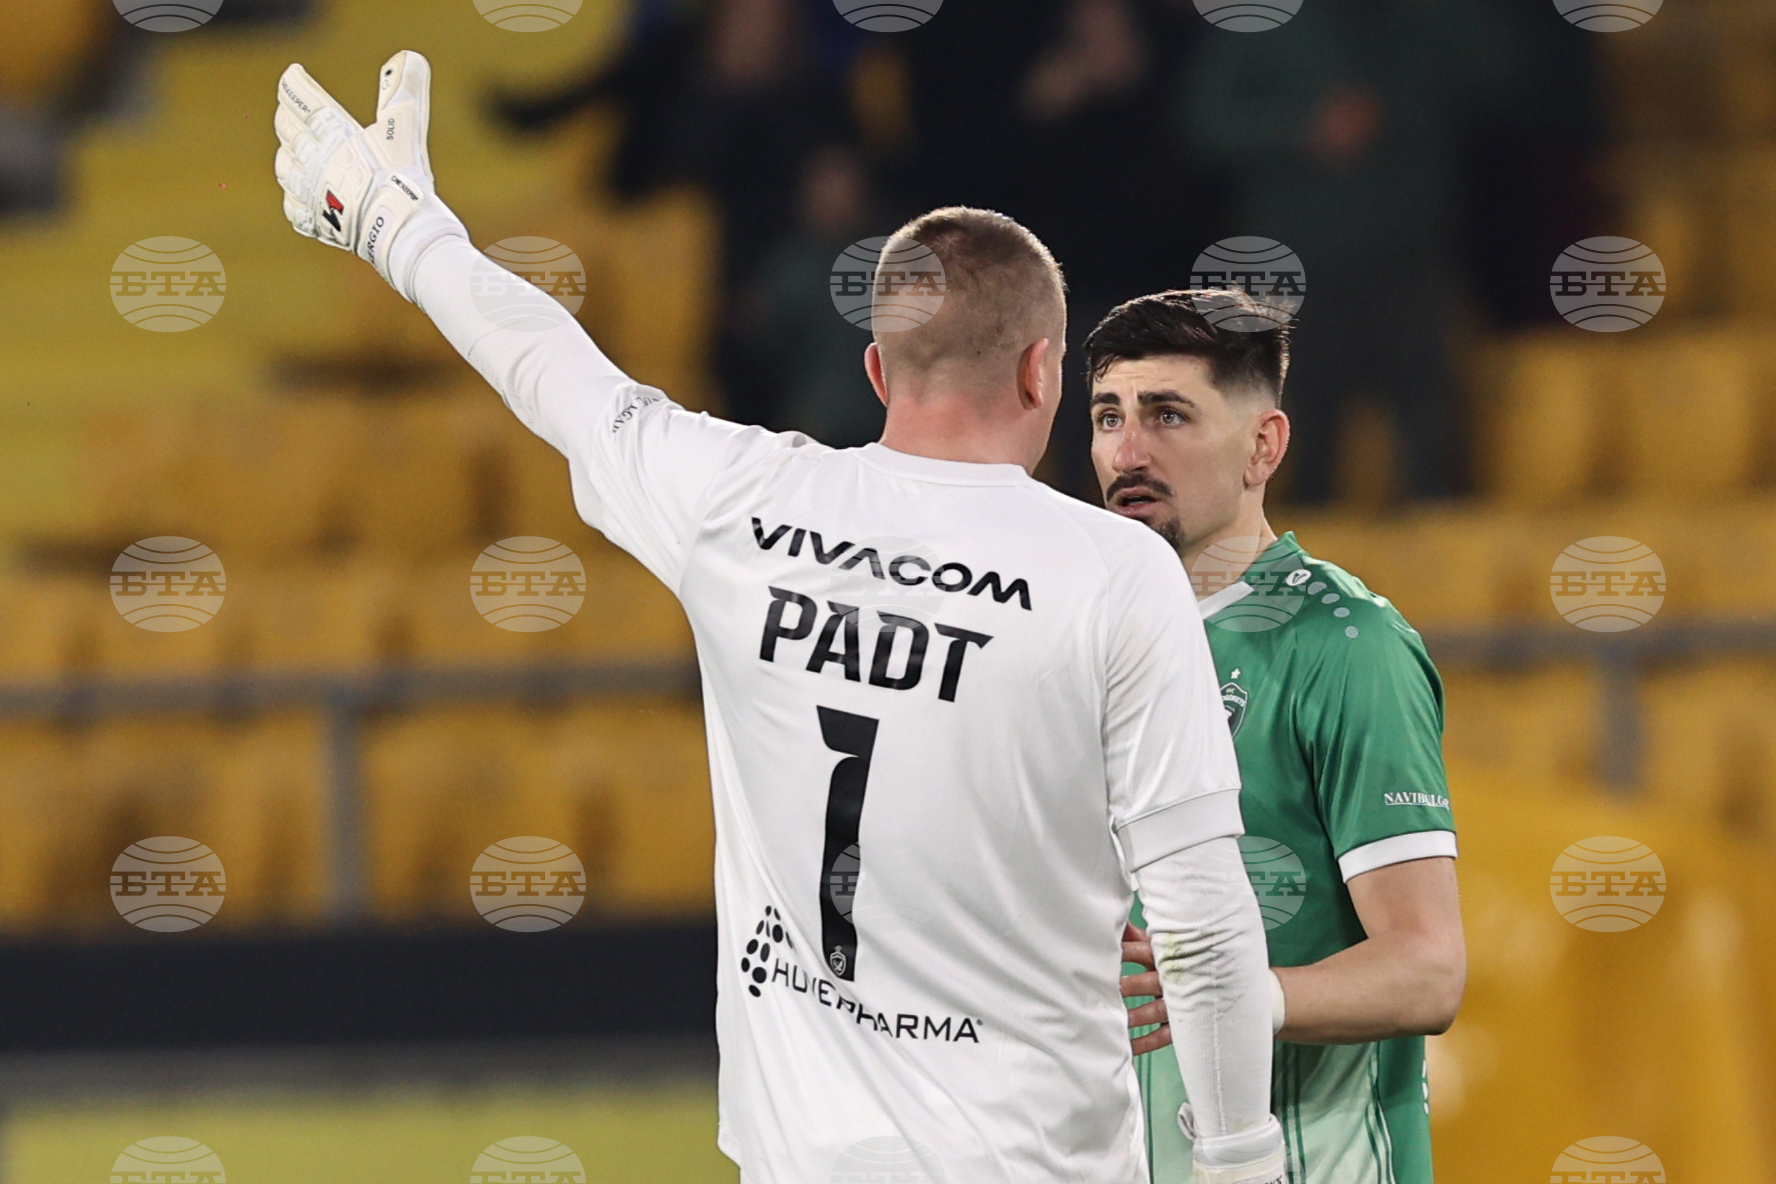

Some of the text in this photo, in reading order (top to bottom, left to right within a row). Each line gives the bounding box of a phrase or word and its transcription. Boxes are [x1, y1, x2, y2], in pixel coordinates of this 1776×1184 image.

[386, 118, 396, 140] SOLID
[751, 516, 1032, 611] VIVACOM
[759, 585, 994, 703] PADT
[816, 704, 879, 982] 1
